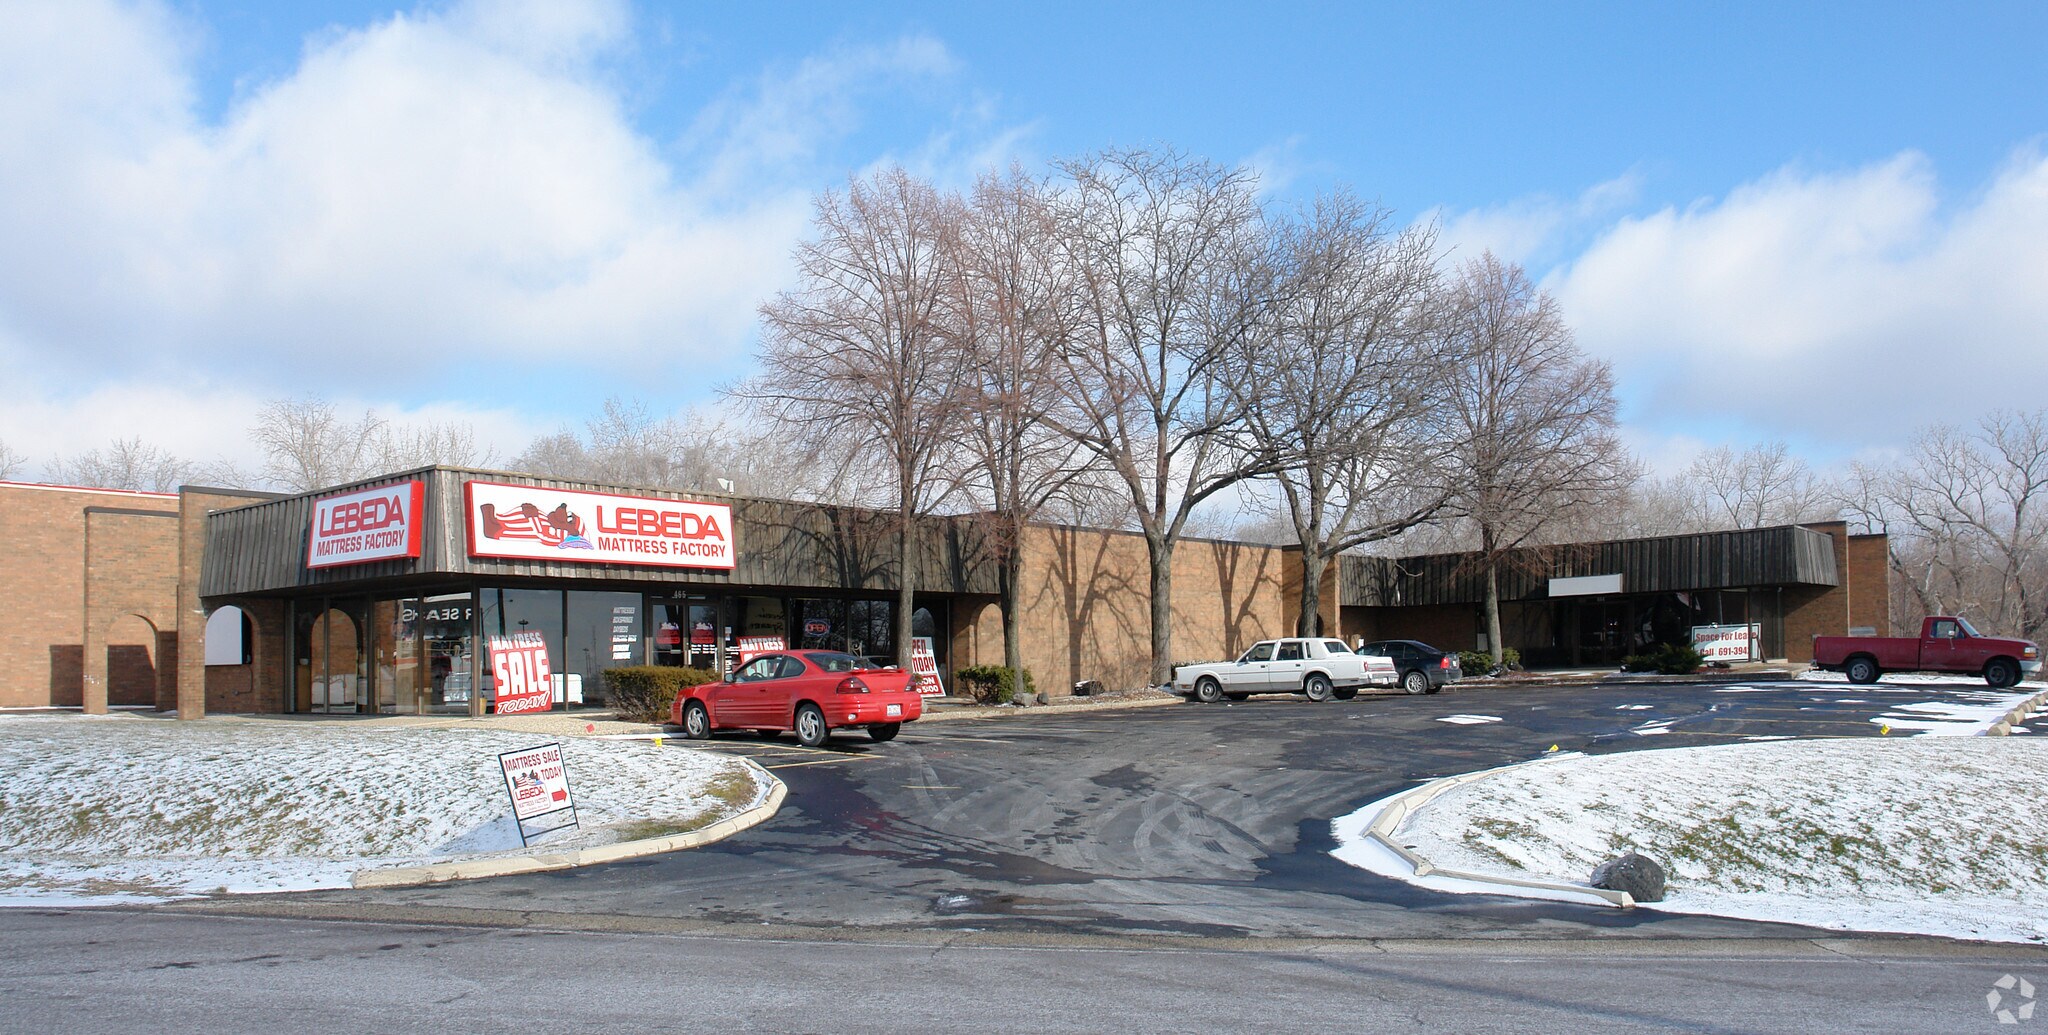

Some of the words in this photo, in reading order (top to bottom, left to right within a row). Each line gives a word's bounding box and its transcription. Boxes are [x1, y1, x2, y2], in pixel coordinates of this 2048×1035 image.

[319, 494, 405, 538] LEBEDA
[596, 505, 725, 541] LEBEDA
[316, 535, 362, 557] MATTRESS
[364, 529, 405, 550] FACTORY
[598, 537, 668, 555] MATTRESS
[673, 541, 726, 558] FACTORY
[807, 623, 827, 632] OPEN
[491, 632, 544, 651] MATTRESS
[739, 637, 784, 651] MATTRESS
[1695, 633, 1720, 643] Space
[1721, 632, 1733, 641] For
[1734, 631, 1757, 640] Leae
[911, 639, 927, 655] PEN
[1700, 648, 1714, 656] Call
[1718, 646, 1749, 656] 691-394
[912, 656, 935, 672] NDAY
[494, 649, 550, 697] SALE
[497, 690, 550, 714] TODAY!
[504, 753, 542, 772] MATTRESS
[542, 749, 560, 764] SALE
[541, 765, 562, 780] TODAY
[514, 786, 545, 800] LEBEDA
